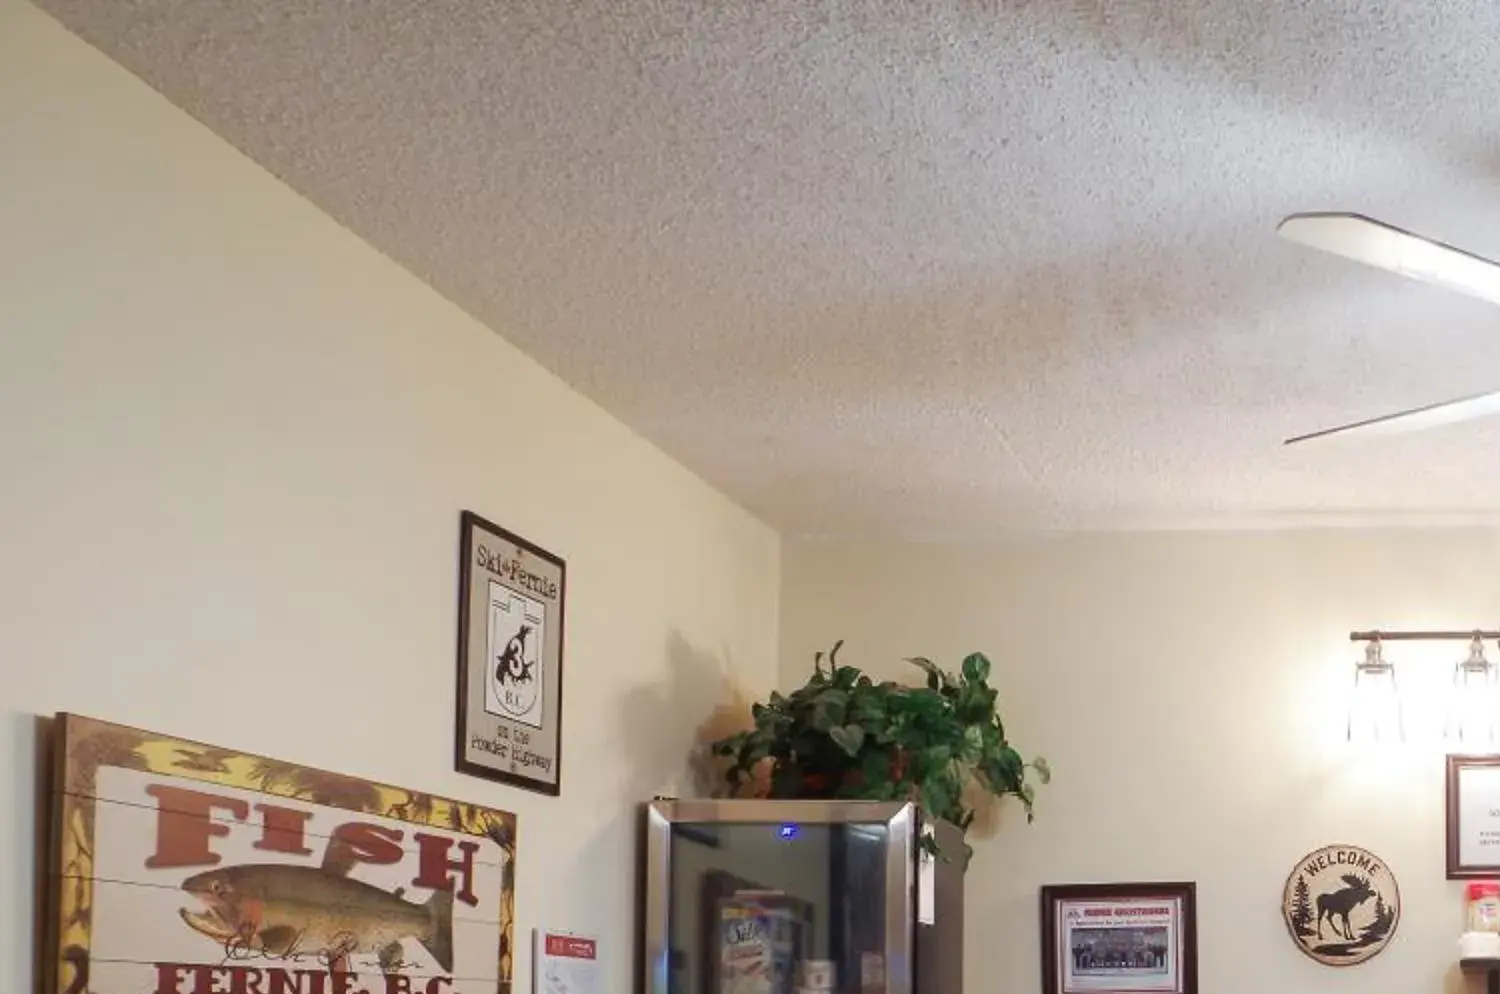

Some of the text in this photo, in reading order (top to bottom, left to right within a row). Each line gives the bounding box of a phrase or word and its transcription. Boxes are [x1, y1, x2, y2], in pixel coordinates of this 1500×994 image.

[477, 543, 556, 600] Ski Fernie
[509, 638, 524, 678] 3
[471, 735, 552, 774] Powder Highway
[144, 783, 480, 907] FISH
[1303, 850, 1381, 878] WELCOME
